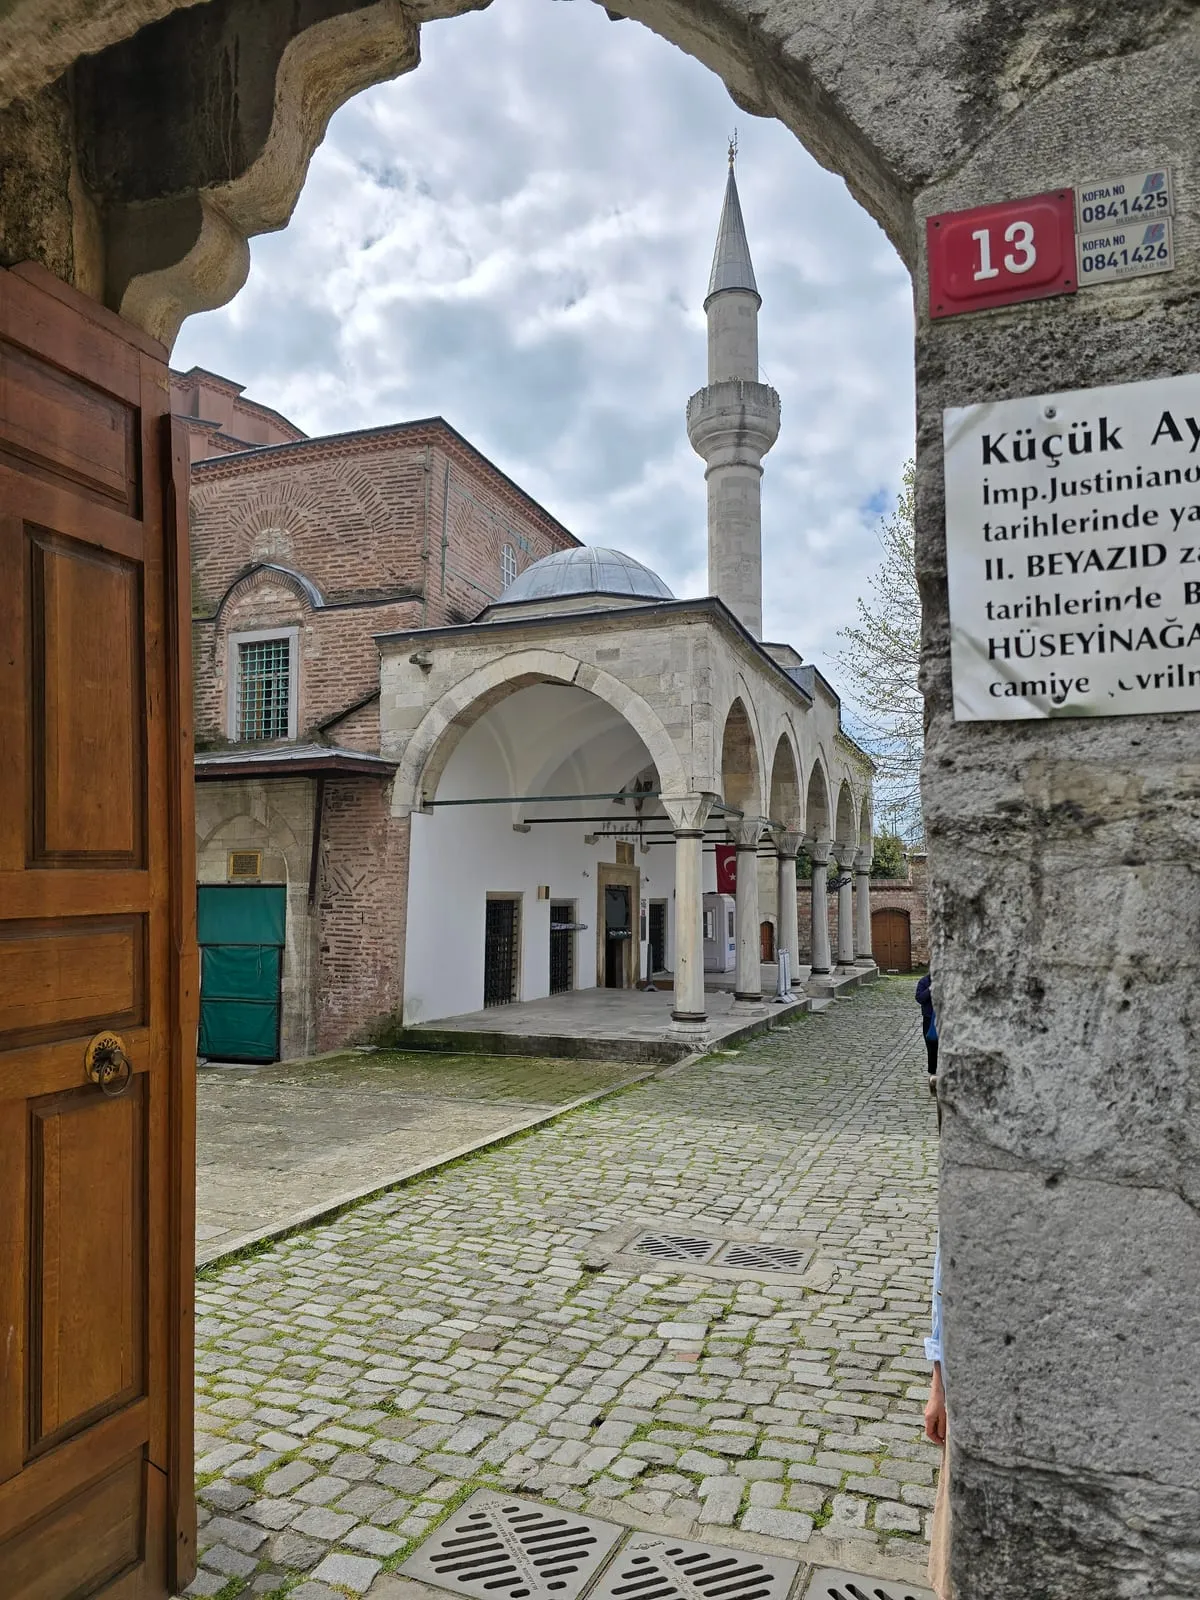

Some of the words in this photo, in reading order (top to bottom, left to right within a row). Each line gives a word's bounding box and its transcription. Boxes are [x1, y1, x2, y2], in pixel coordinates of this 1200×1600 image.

[1082, 188, 1111, 202] KOFRA
[1113, 184, 1125, 197] NO
[1082, 191, 1168, 224] 0841425
[972, 221, 1037, 281] 13
[1082, 238, 1111, 252] KOFRA
[1113, 234, 1126, 247] NO
[1082, 242, 1168, 273] 0841426
[981, 416, 1123, 468] Küçük
[1150, 411, 1200, 453] Ay
[982, 504, 1160, 543] tarihlerinde
[1169, 505, 1200, 532] ya
[985, 557, 1015, 581] II.
[1027, 543, 1168, 578] BEYAZID
[1179, 546, 1200, 565] z
[985, 586, 1163, 621] tarihlerinde
[987, 617, 1200, 661] HÜSEYİNAĞA
[988, 672, 1091, 700] camiye
